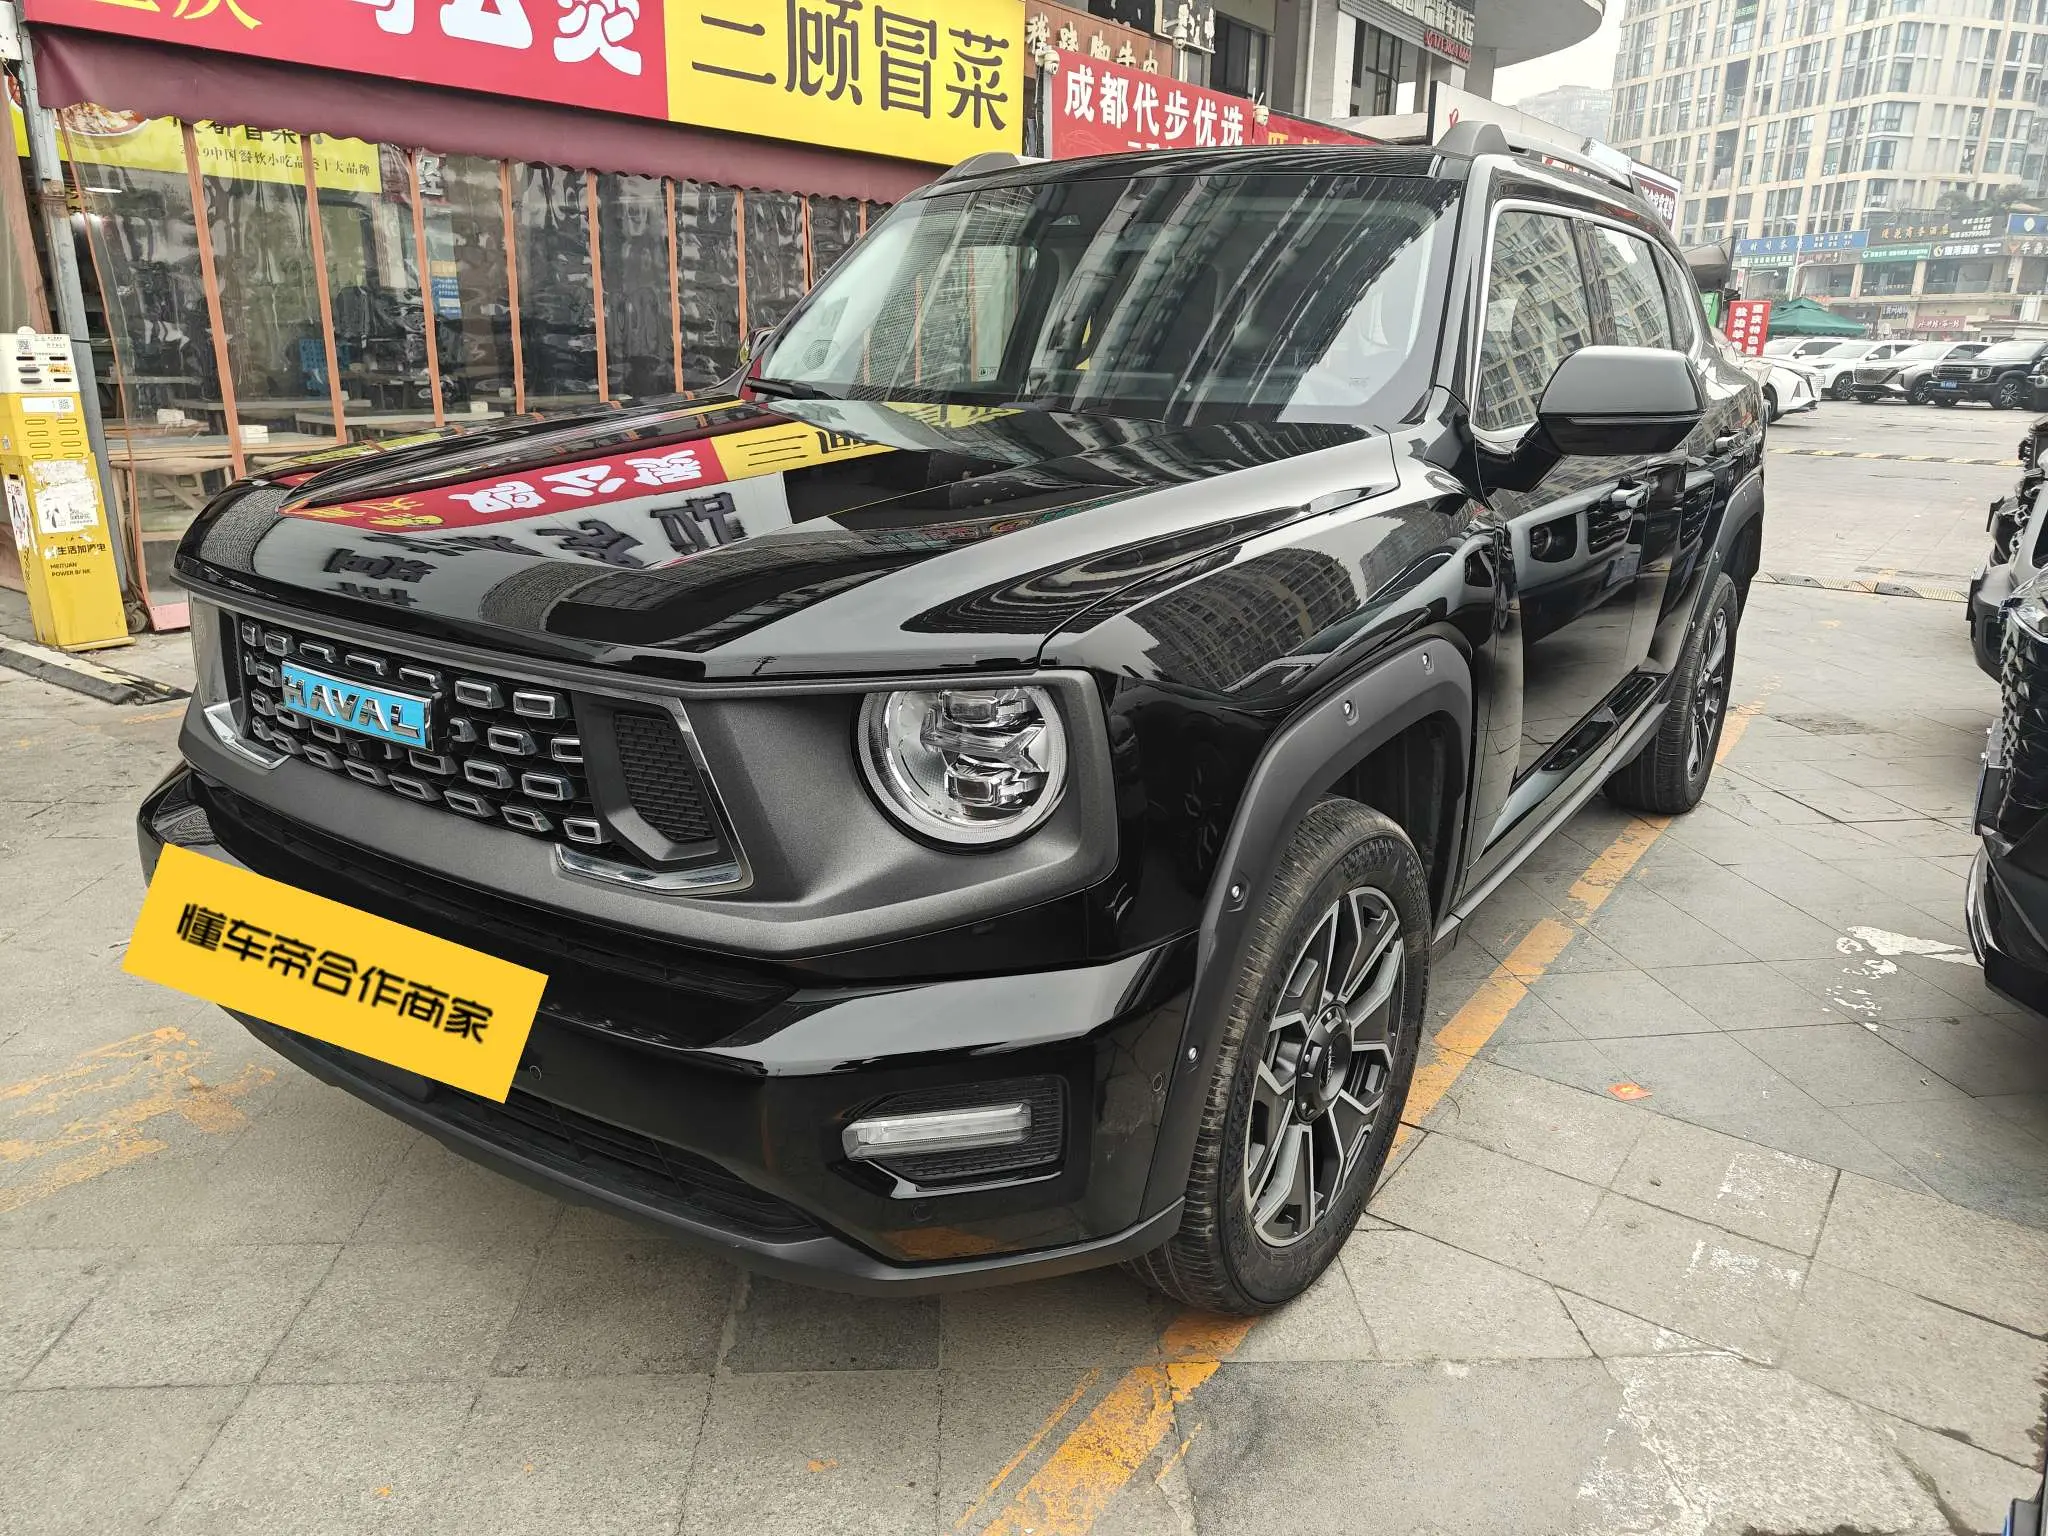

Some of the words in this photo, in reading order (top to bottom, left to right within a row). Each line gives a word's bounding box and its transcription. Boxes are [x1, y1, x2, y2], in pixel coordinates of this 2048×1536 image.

[1064, 64, 1244, 147] 成都代步优选
[282, 674, 421, 740] HAVAL
